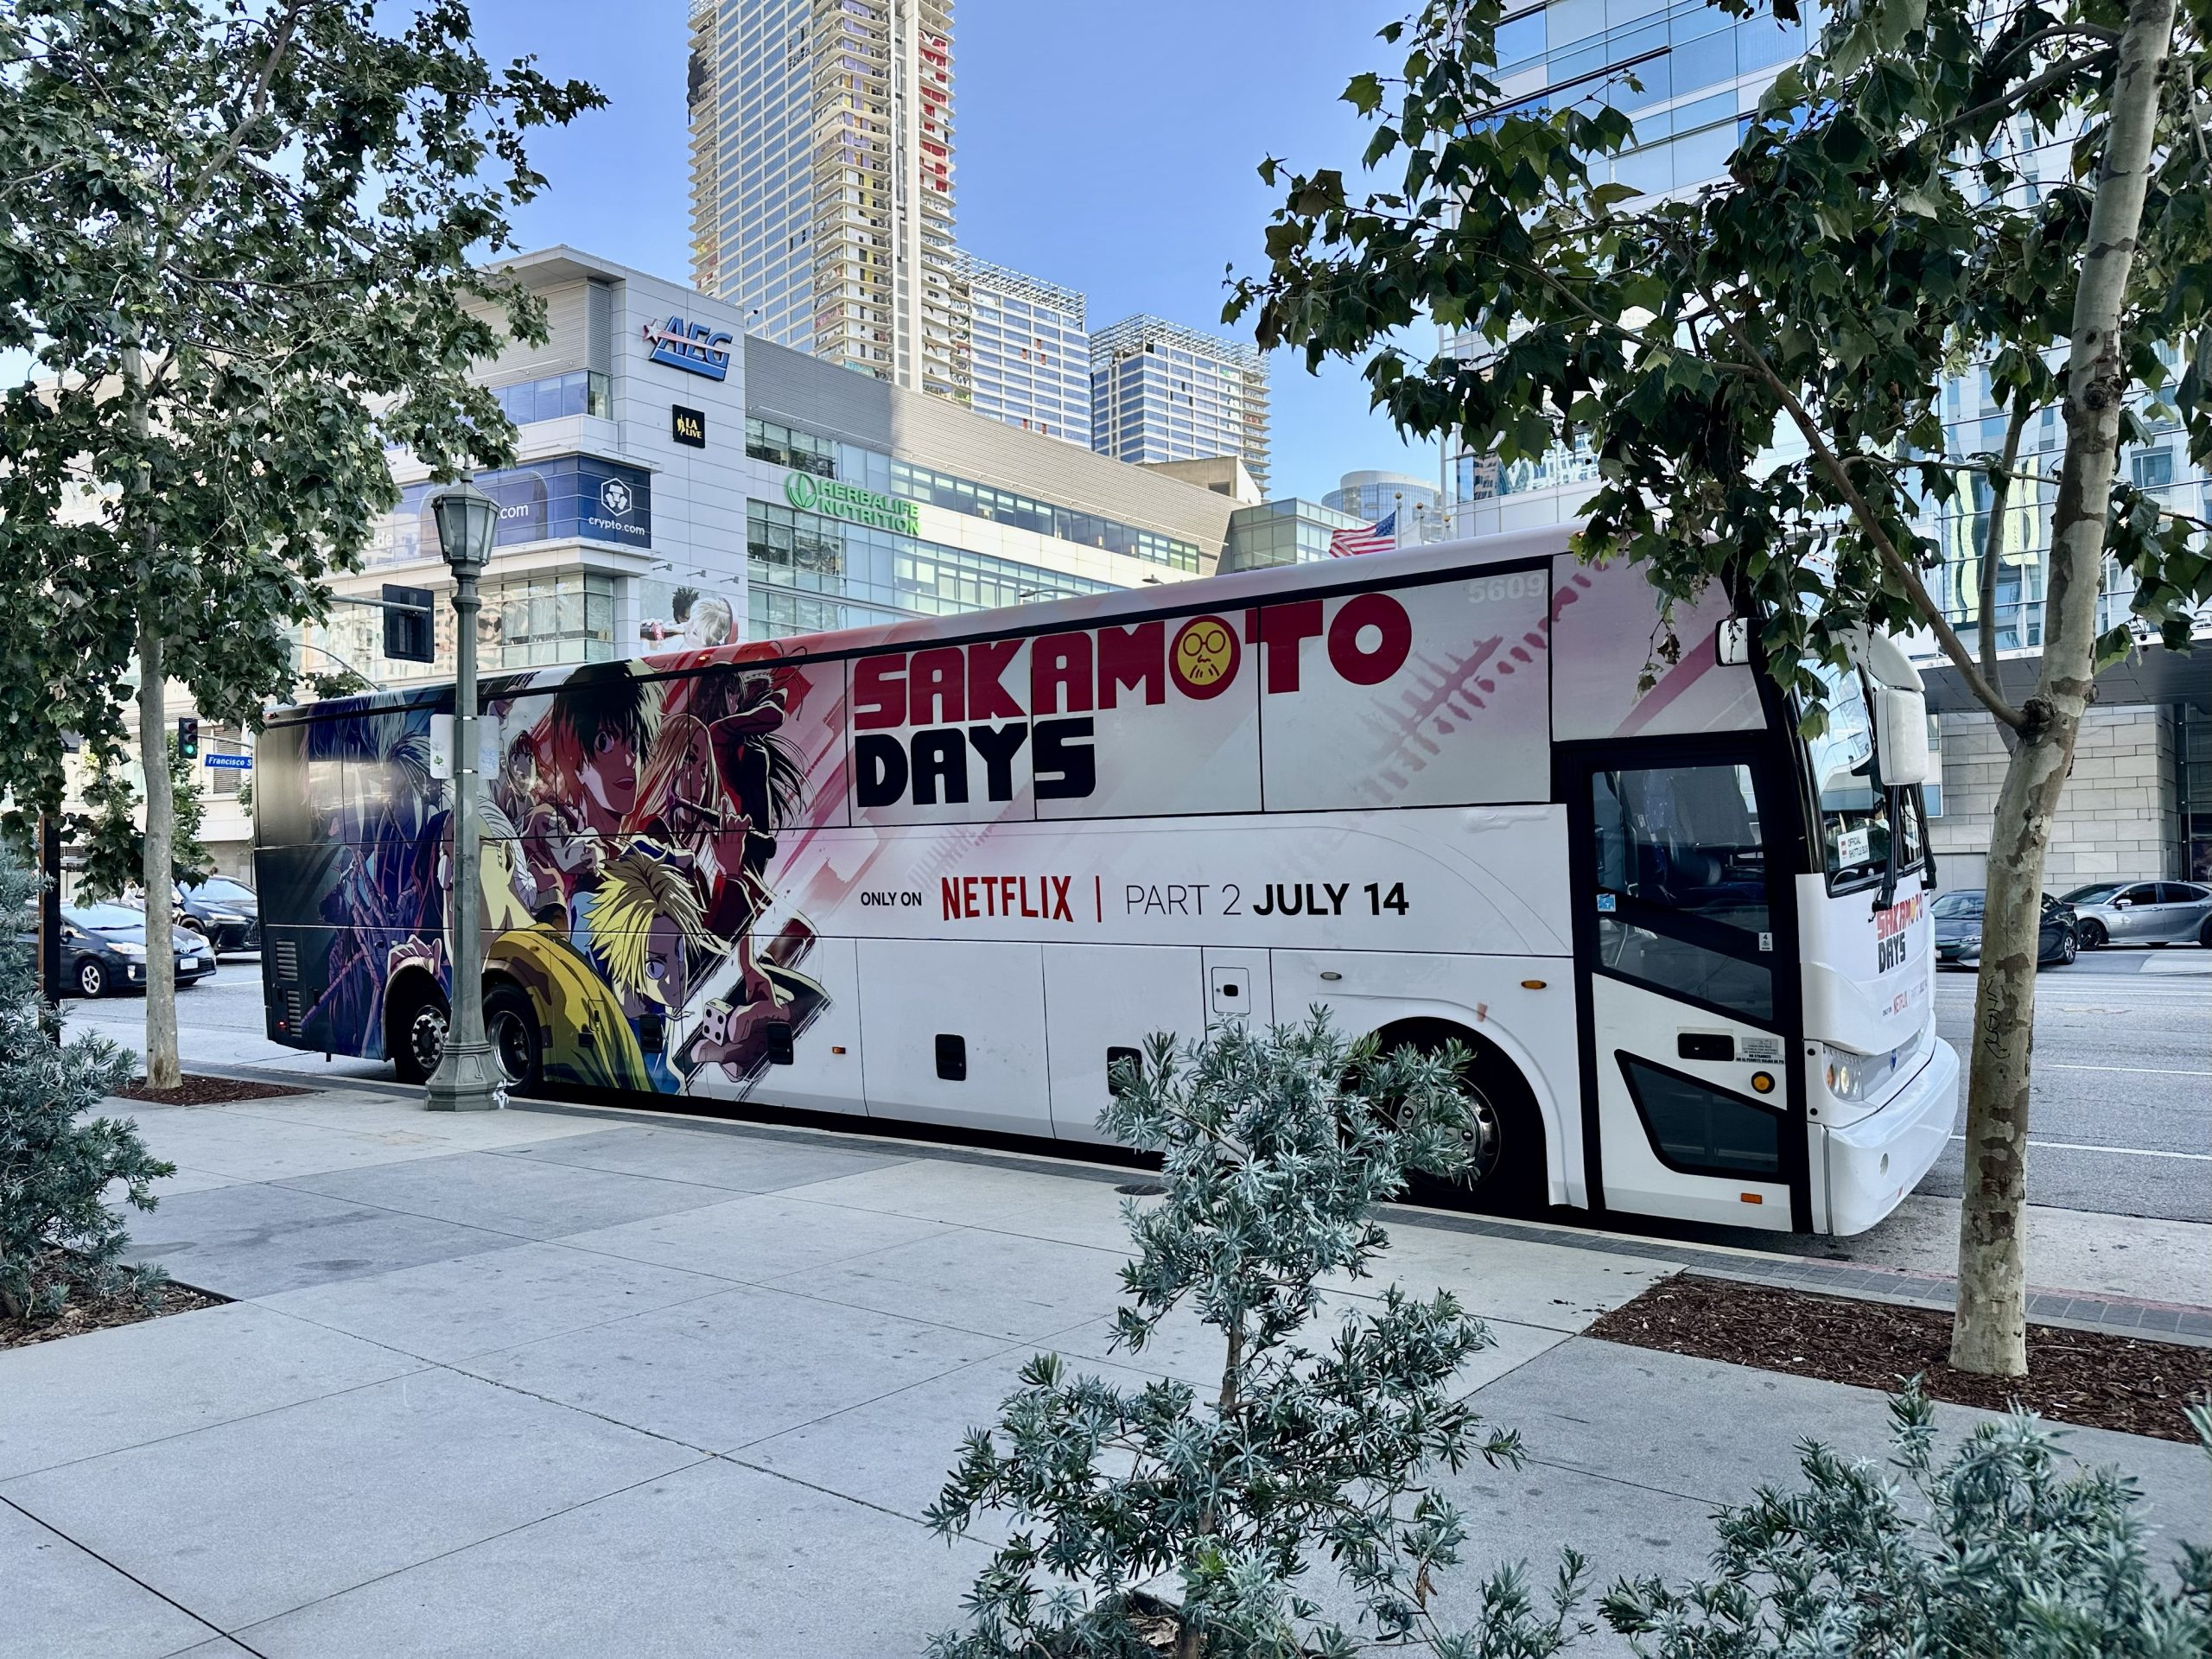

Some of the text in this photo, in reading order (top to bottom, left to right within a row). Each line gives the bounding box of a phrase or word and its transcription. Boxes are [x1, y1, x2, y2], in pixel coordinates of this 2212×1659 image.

[653, 315, 733, 370] AEG
[685, 417, 698, 430] LA
[686, 428, 702, 439] LIVE
[820, 499, 920, 536] NUTRITION
[821, 479, 919, 518] HERBALIFE
[588, 517, 645, 536] crypto.com
[1468, 573, 1546, 604] 5609
[854, 593, 1413, 731] SAKAMOTO
[208, 756, 245, 766] Francisco
[854, 716, 1096, 808] DAYS
[861, 875, 1409, 923] ONLY ON NETFLIX PART 2 JULY 14
[1877, 892, 1923, 941] SAKAMOTO
[1878, 931, 1906, 974] DAYS
